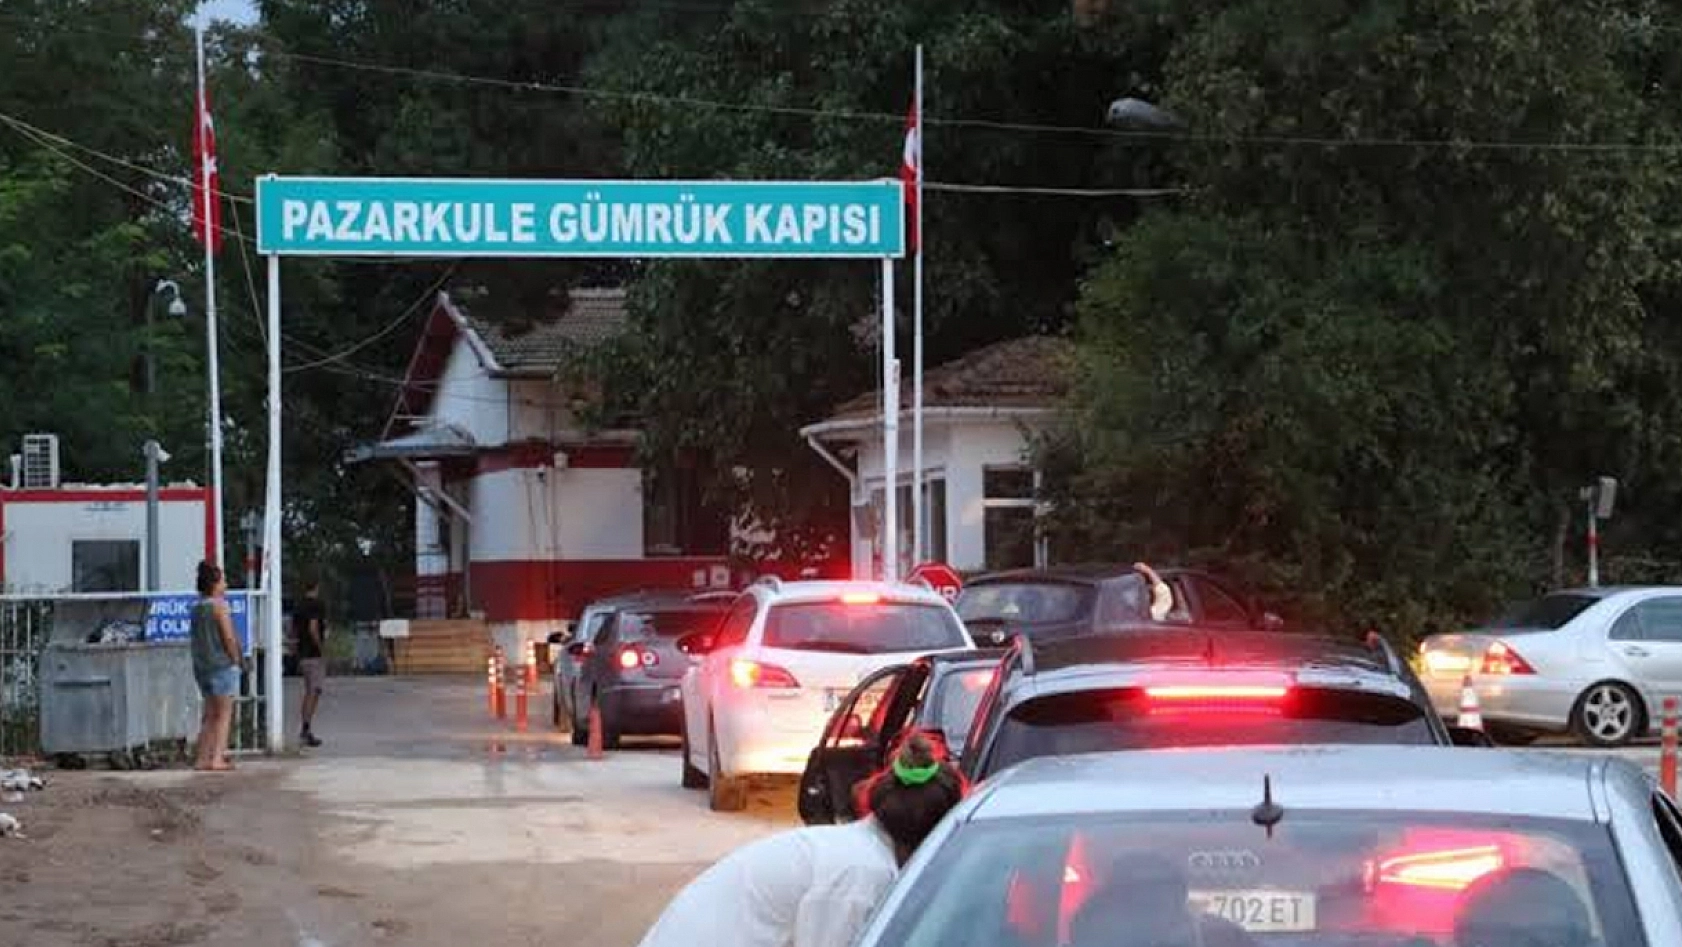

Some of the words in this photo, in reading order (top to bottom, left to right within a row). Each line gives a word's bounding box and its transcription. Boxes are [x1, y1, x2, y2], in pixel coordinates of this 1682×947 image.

[282, 199, 536, 242] PAZARKULE
[549, 190, 732, 244] GÜMRÜK
[745, 203, 881, 244] KAPISI
